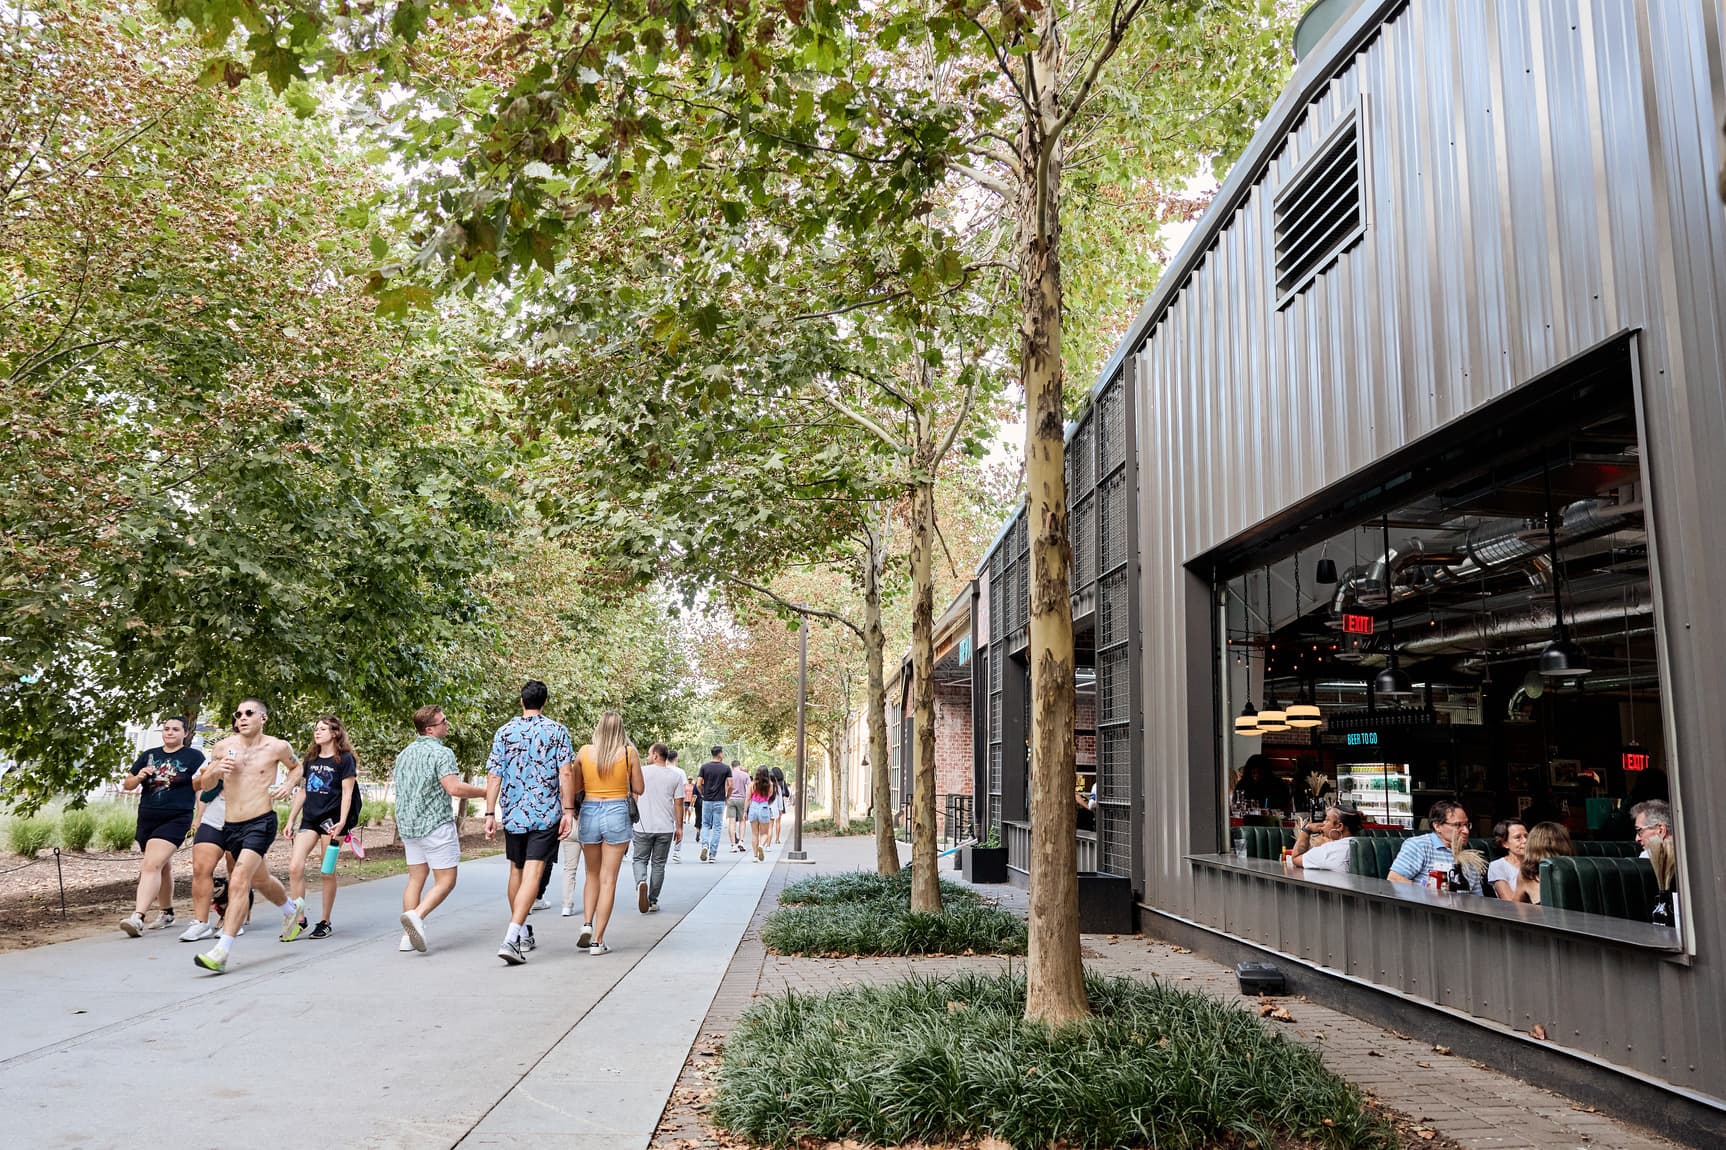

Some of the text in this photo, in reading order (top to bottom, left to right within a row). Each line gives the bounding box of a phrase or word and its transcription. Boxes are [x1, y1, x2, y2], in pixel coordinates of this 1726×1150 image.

[1349, 615, 1369, 632] EXIT
[1347, 732, 1377, 745] BEER TO GO
[1627, 753, 1644, 769] EXIT
